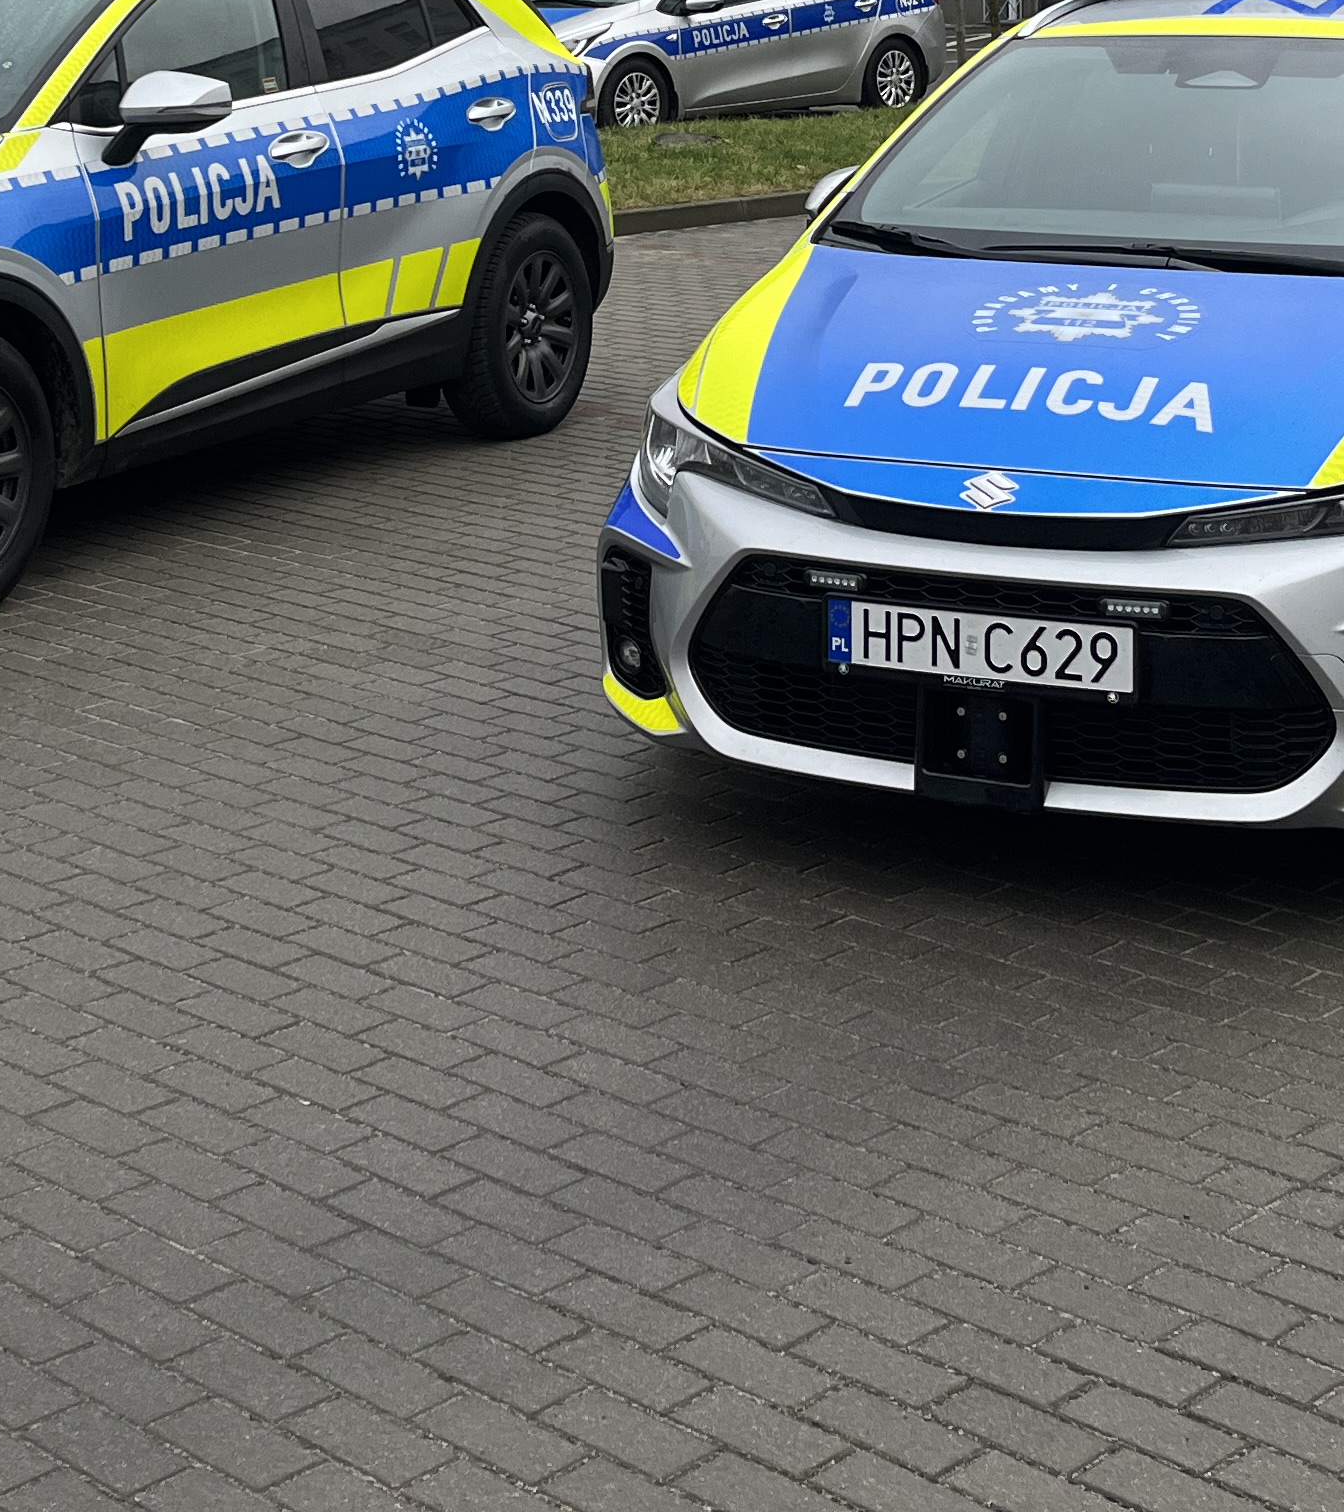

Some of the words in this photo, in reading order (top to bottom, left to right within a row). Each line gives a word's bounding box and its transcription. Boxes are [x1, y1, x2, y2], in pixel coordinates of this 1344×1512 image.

[692, 21, 750, 48] POLICJA
[531, 88, 577, 124] N339
[113, 154, 282, 242] POLICJA
[971, 283, 1079, 333] POMAGAMY
[1042, 300, 1140, 312] POLICJA
[1062, 319, 1098, 328] 112
[843, 361, 1215, 434] POLICJA
[831, 636, 850, 653] PL
[862, 607, 961, 670] HPN
[983, 621, 1119, 684] C629
[942, 674, 1006, 689] MAKURAT
